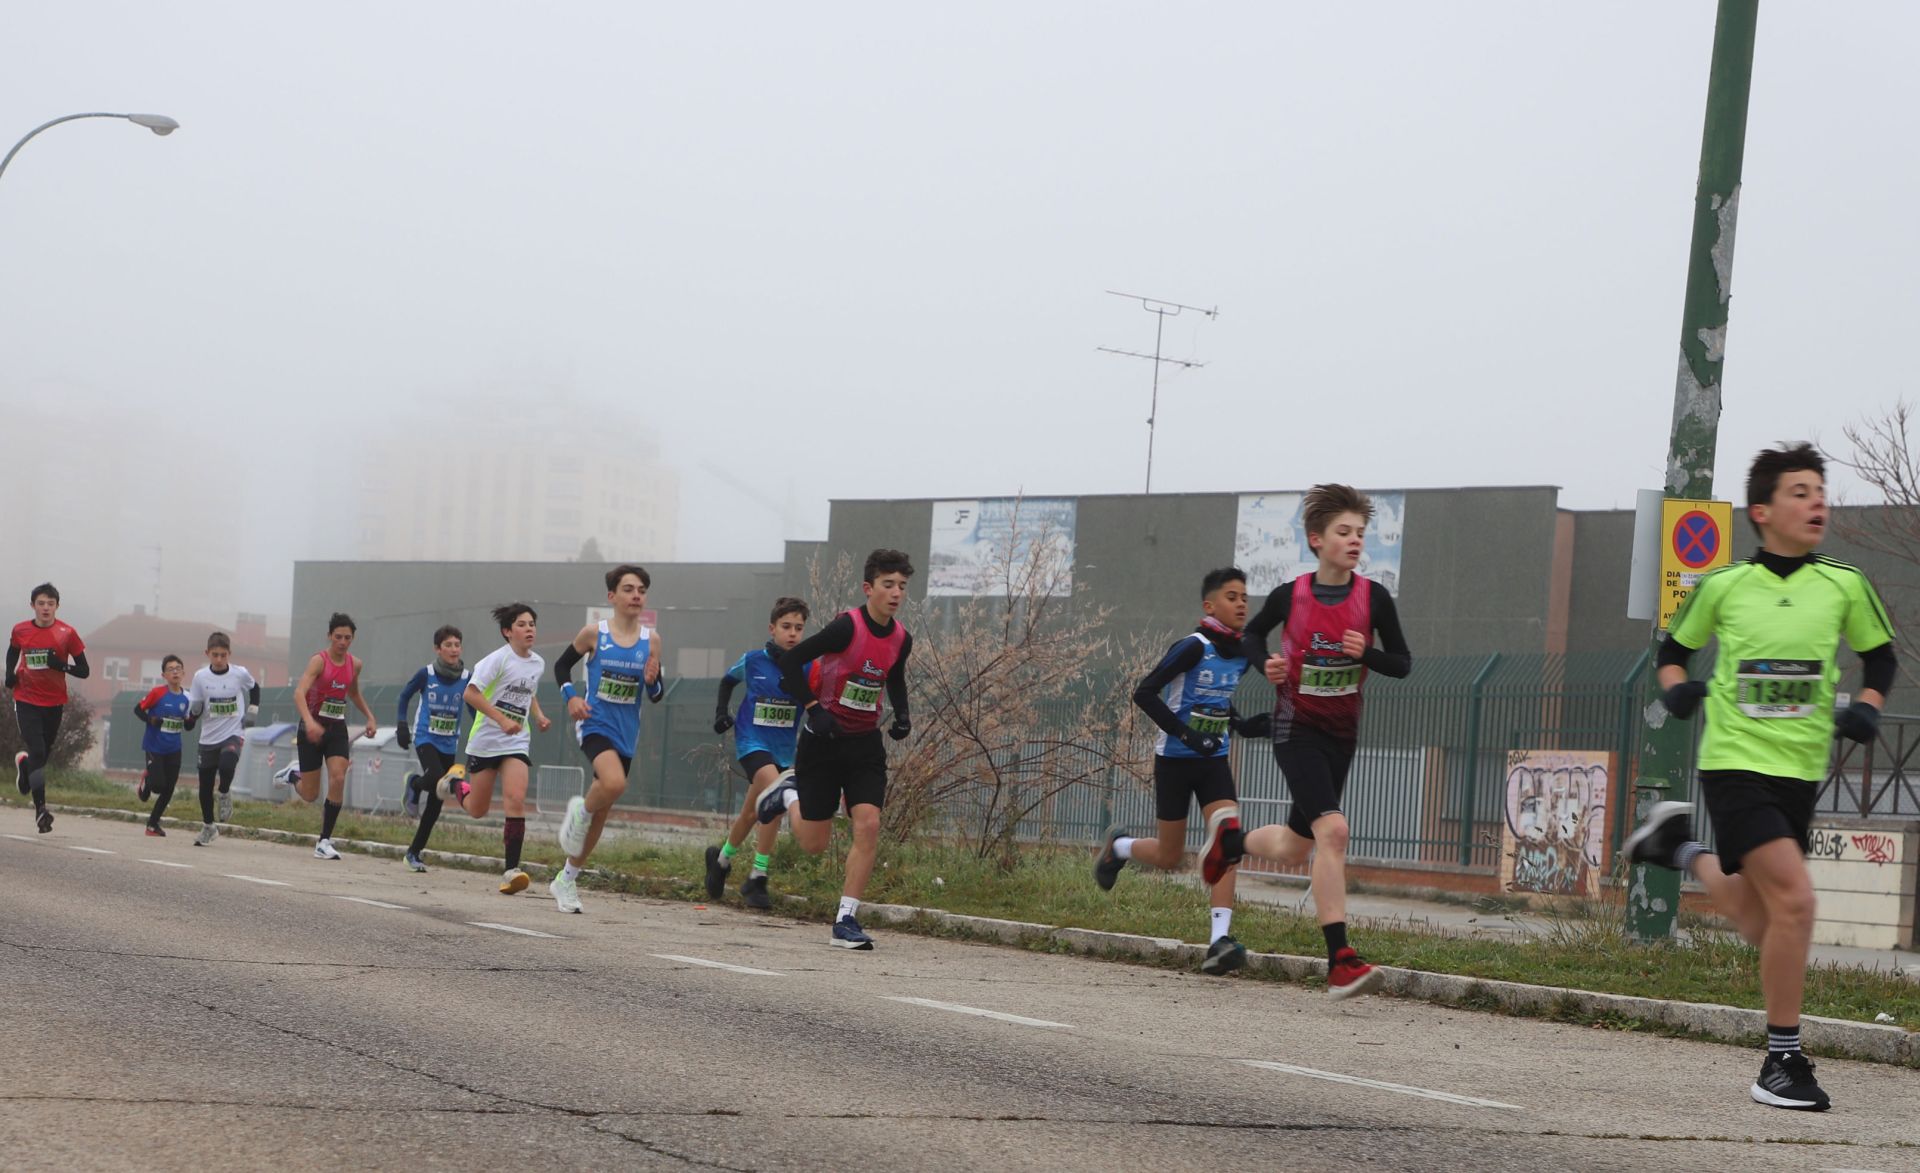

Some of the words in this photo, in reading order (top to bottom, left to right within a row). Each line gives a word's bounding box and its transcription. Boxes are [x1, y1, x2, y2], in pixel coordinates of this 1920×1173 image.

[1673, 590, 1690, 599] PO
[1313, 670, 1353, 687] 1271
[1751, 681, 1810, 703] 1340
[762, 706, 791, 720] 1306
